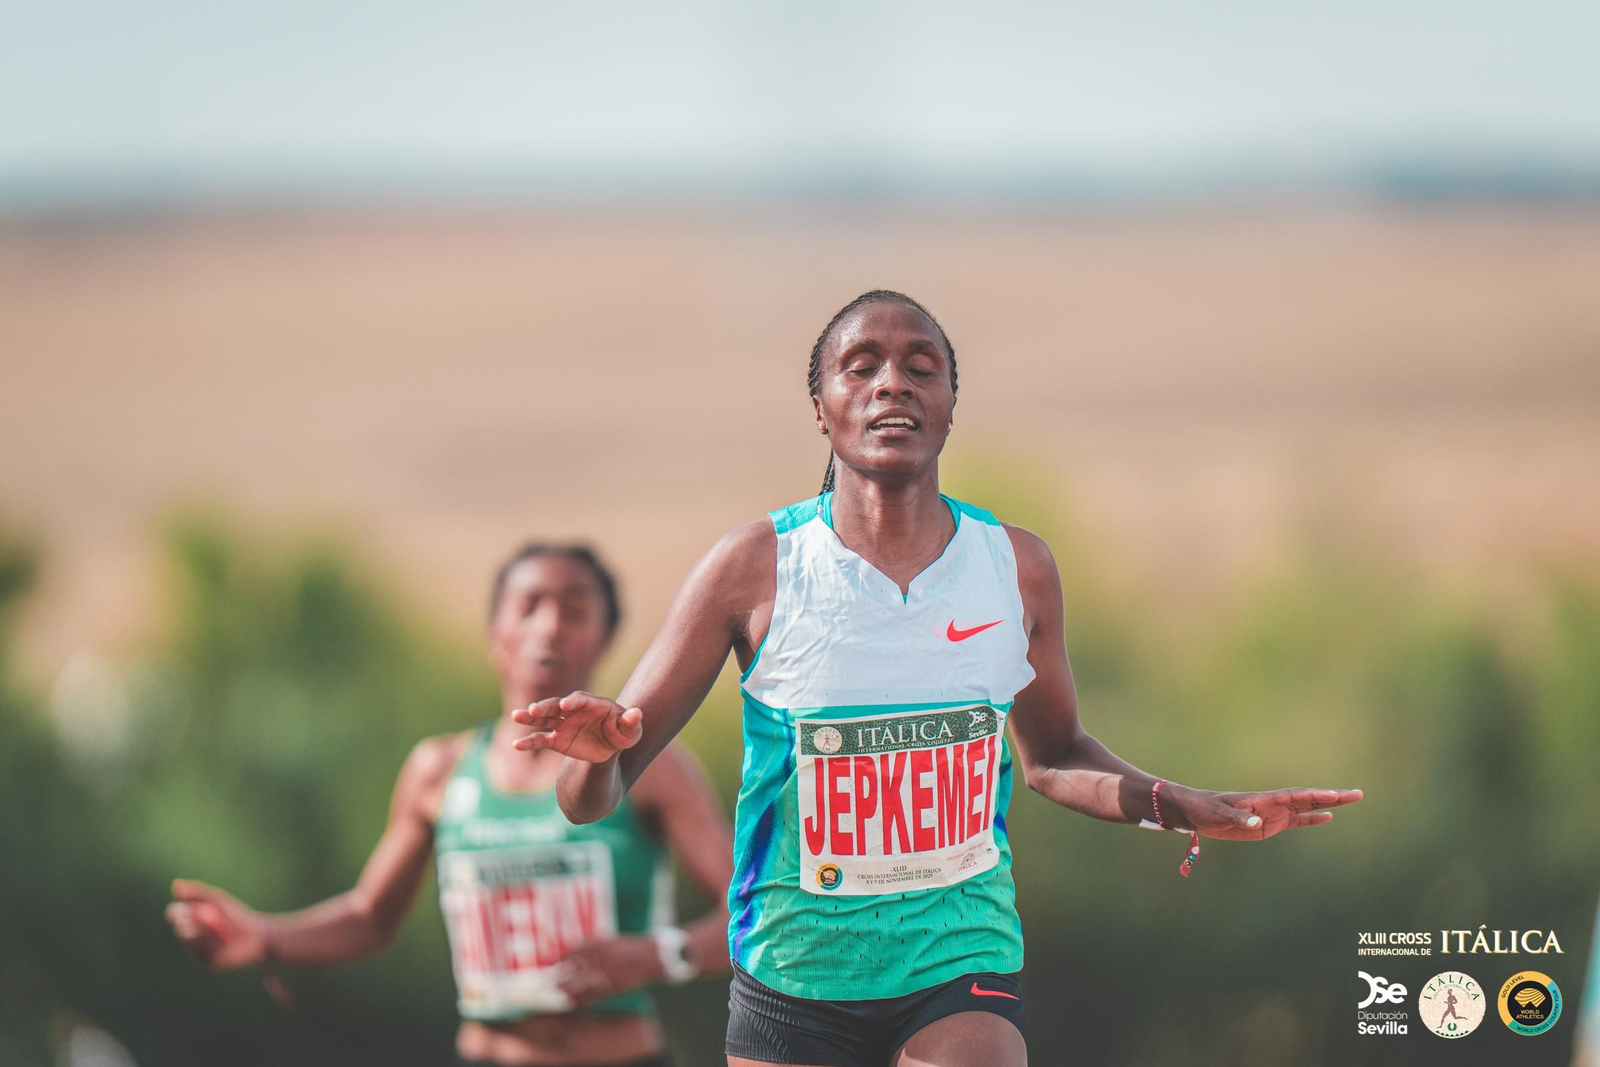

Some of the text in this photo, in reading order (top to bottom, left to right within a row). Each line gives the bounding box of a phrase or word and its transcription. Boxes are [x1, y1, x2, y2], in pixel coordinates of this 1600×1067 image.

[857, 720, 954, 748] ITÁLICA
[858, 743, 906, 753] INTERNATIONAL
[927, 738, 954, 746] COUNTRY
[804, 734, 996, 857] JEPKEMEI
[874, 870, 914, 879] INTERNACIONAL
[886, 876, 914, 884] NOVIEMBRE
